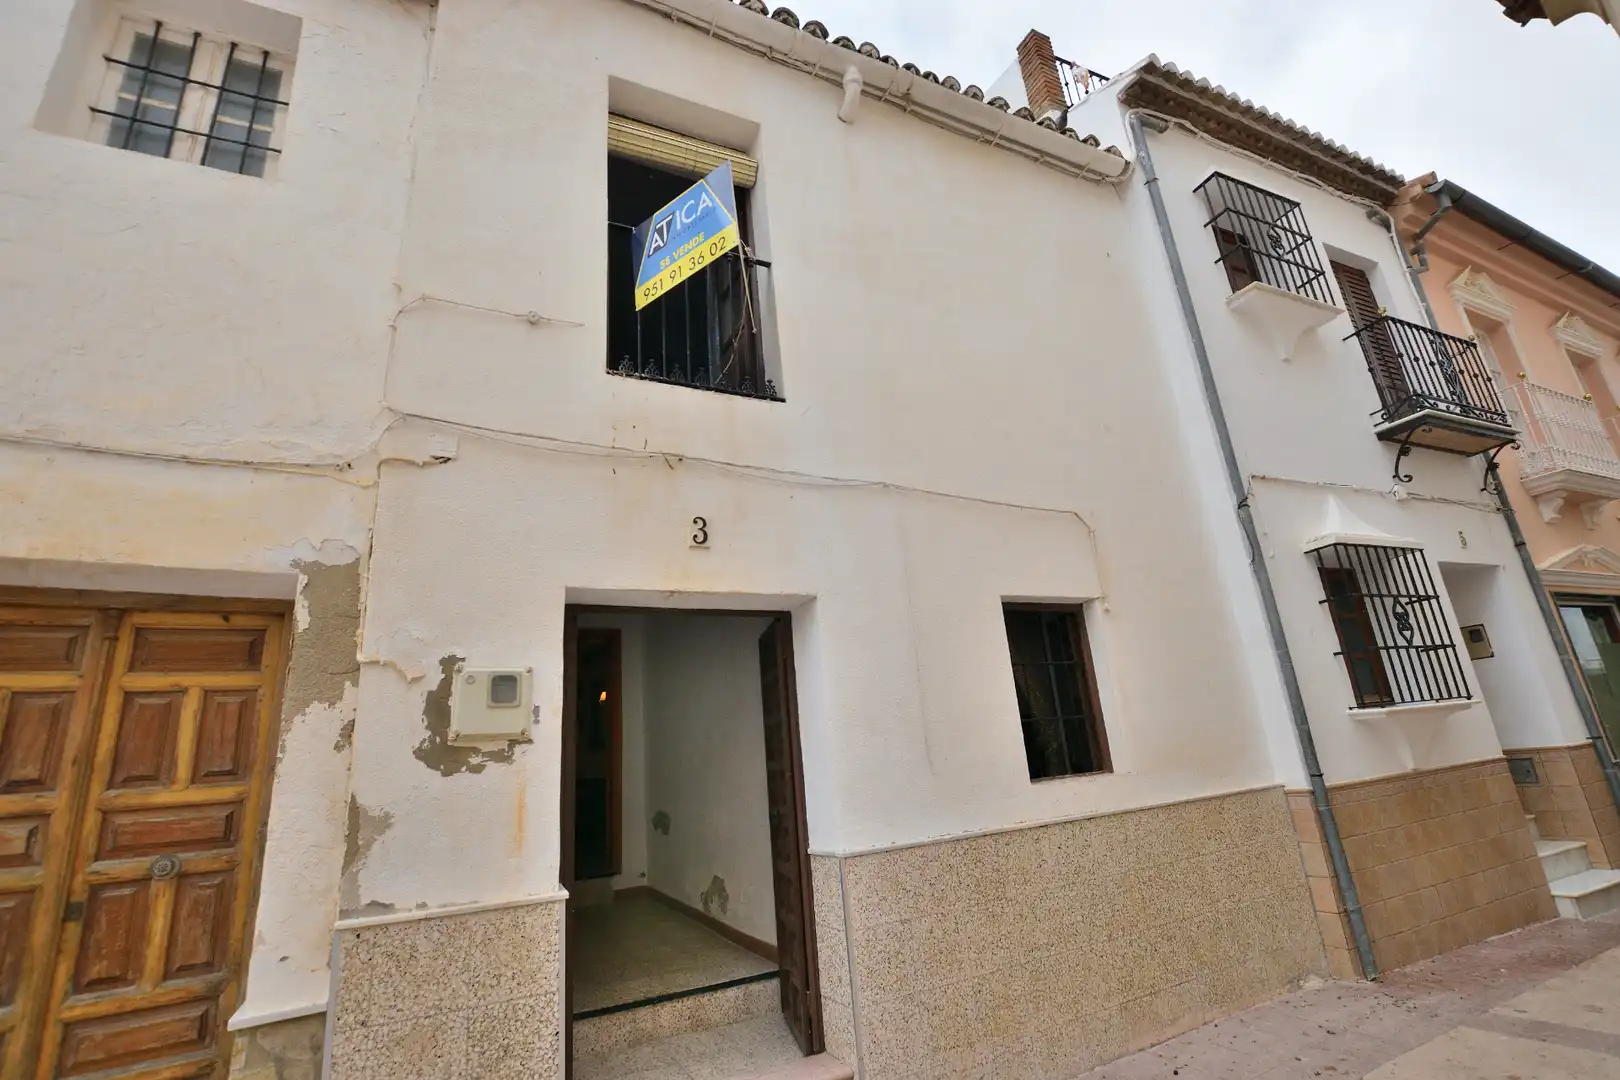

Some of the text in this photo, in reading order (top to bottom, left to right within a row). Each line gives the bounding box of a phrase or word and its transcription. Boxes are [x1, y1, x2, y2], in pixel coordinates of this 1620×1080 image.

[649, 191, 712, 255] ATICA
[643, 236, 727, 301] 951 91 36 02
[660, 232, 705, 270] SE VENDE
[692, 516, 708, 545] 3
